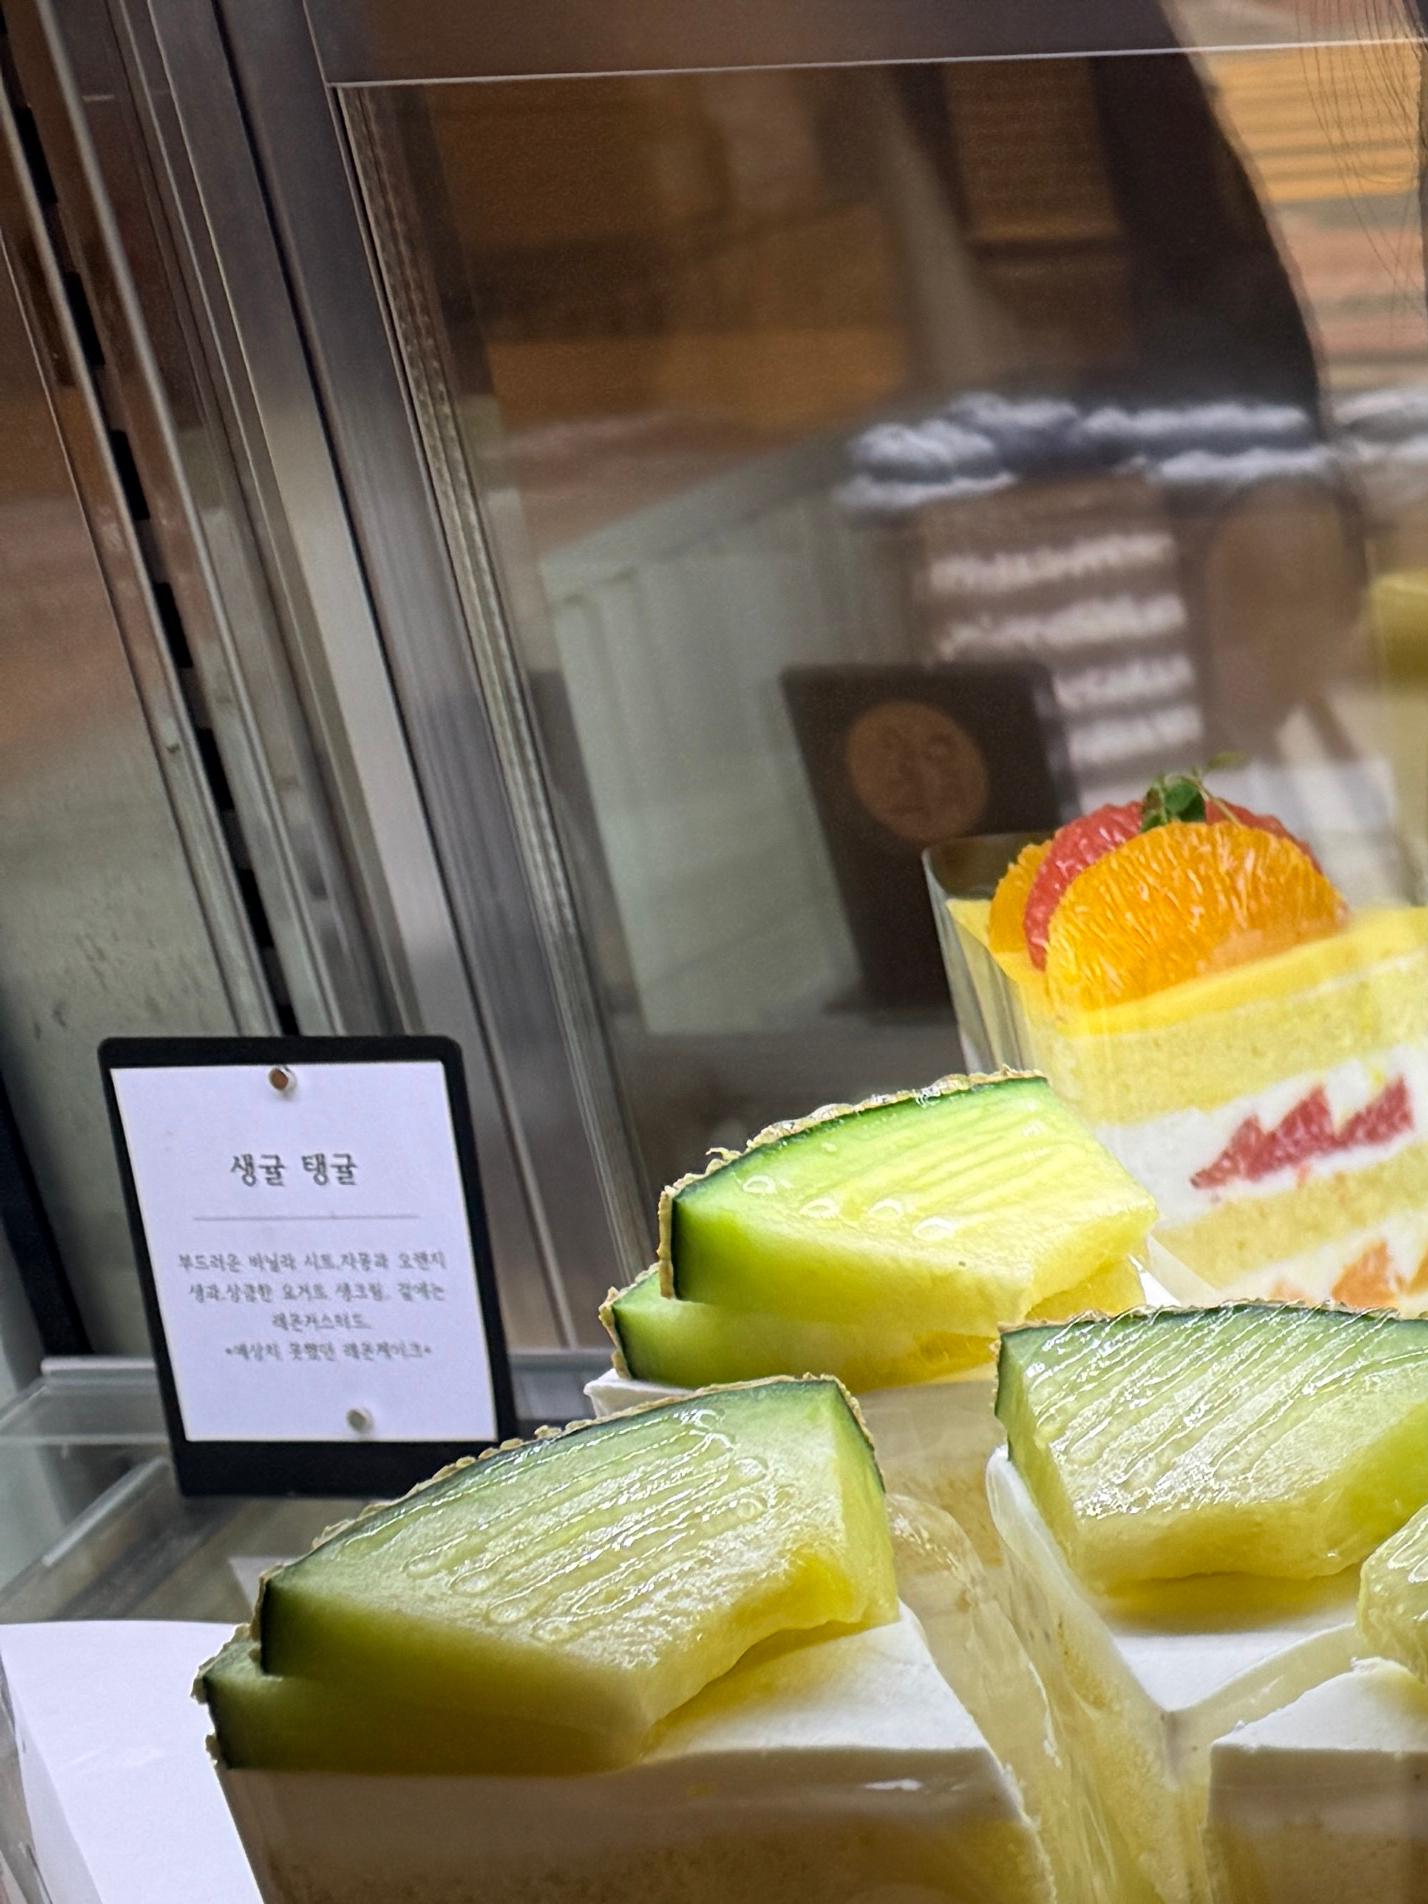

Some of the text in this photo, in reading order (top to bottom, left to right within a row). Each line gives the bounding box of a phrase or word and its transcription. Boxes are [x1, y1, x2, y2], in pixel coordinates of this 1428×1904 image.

[230, 1152, 358, 1188] 생귤 탱귤
[178, 1252, 241, 1274] 부드러운
[247, 1252, 297, 1274] 바닐라
[397, 1250, 447, 1272] 오렌지
